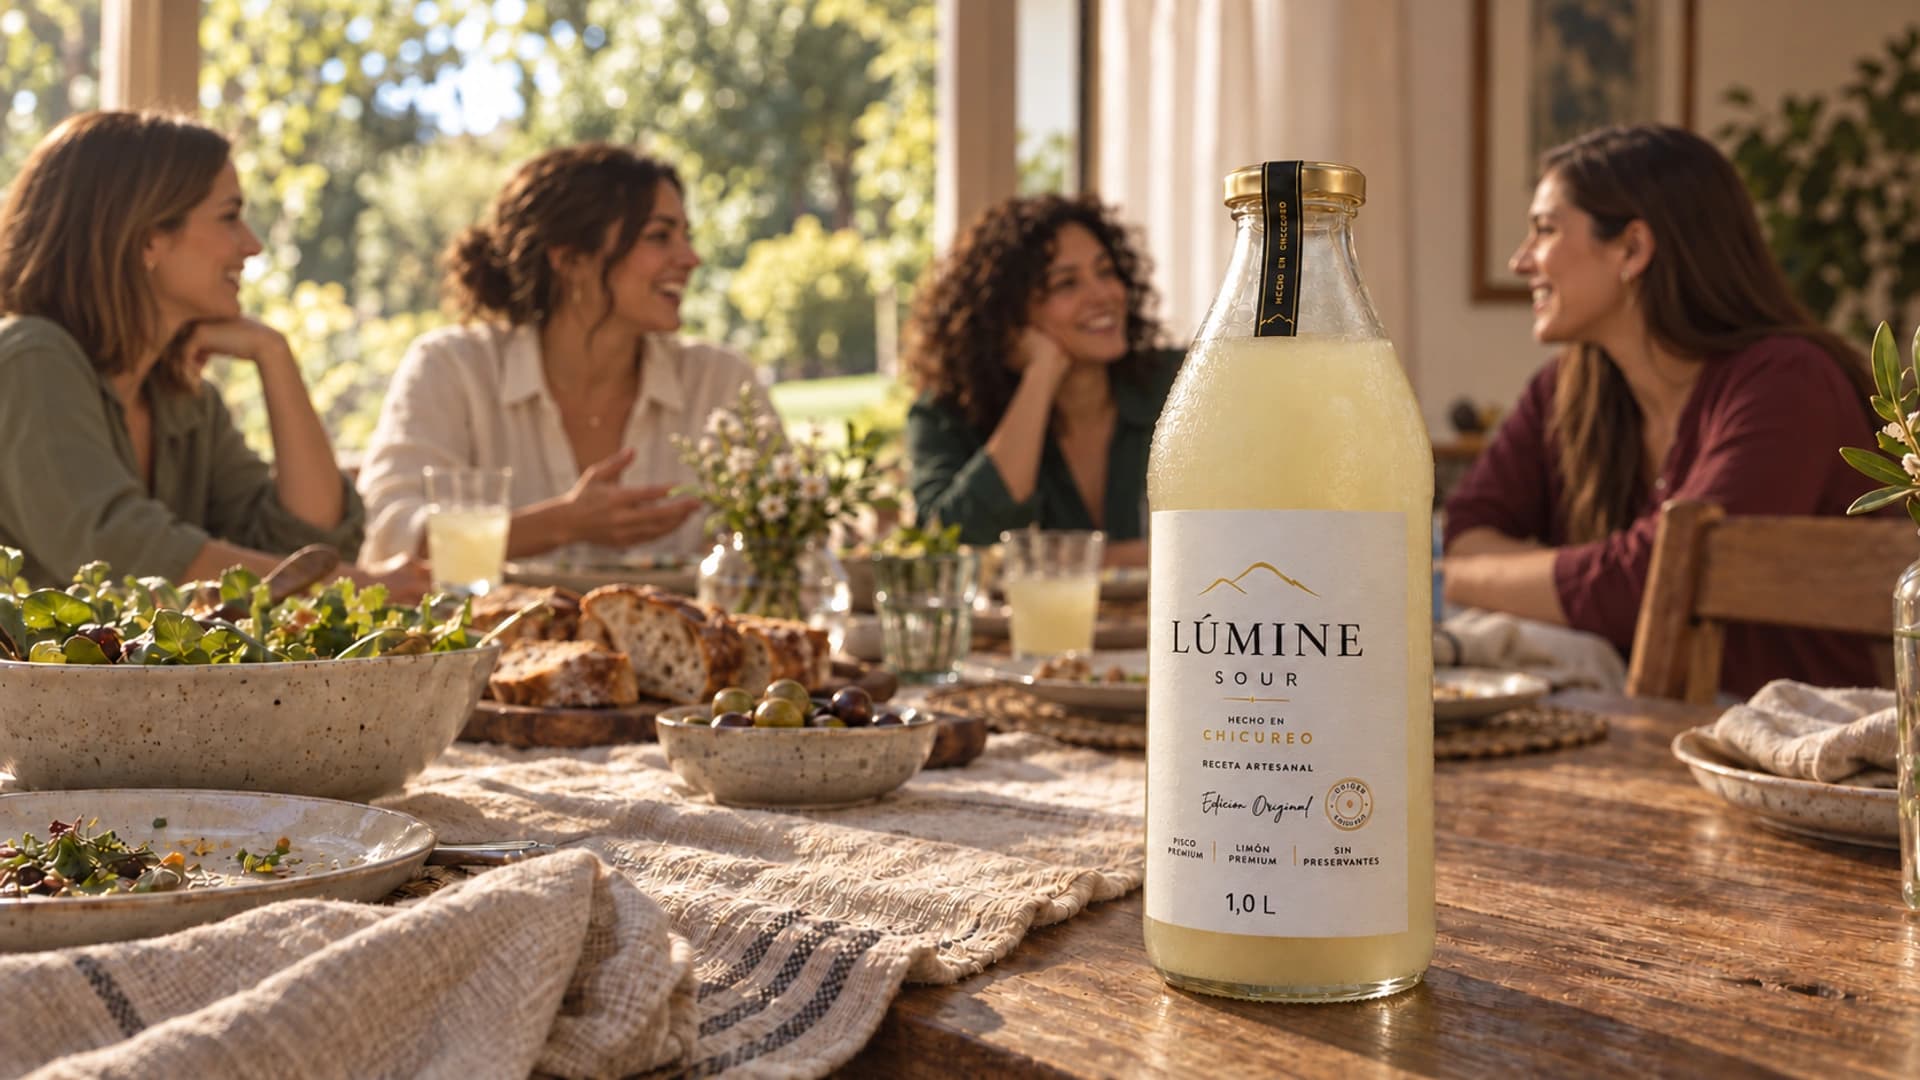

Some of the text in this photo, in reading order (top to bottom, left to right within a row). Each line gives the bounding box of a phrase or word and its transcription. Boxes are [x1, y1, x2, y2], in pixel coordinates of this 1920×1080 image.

[1172, 613, 1364, 657] LÚMINE
[1215, 670, 1298, 687] SOUR
[1228, 716, 1285, 725] HECHO EN
[1203, 729, 1313, 745] CHICUREO
[1202, 760, 1314, 772] RECETA ARTESANAL
[1252, 794, 1314, 823] Original
[1173, 837, 1196, 847] PISCO
[1235, 843, 1270, 853] LIMÓN
[1167, 847, 1204, 860] PREMIUM
[1334, 846, 1352, 854] SIN
[1228, 854, 1277, 865] PREMIUM
[1303, 857, 1380, 866] PRESERVANTES
[1225, 892, 1276, 916] 1,0 L
